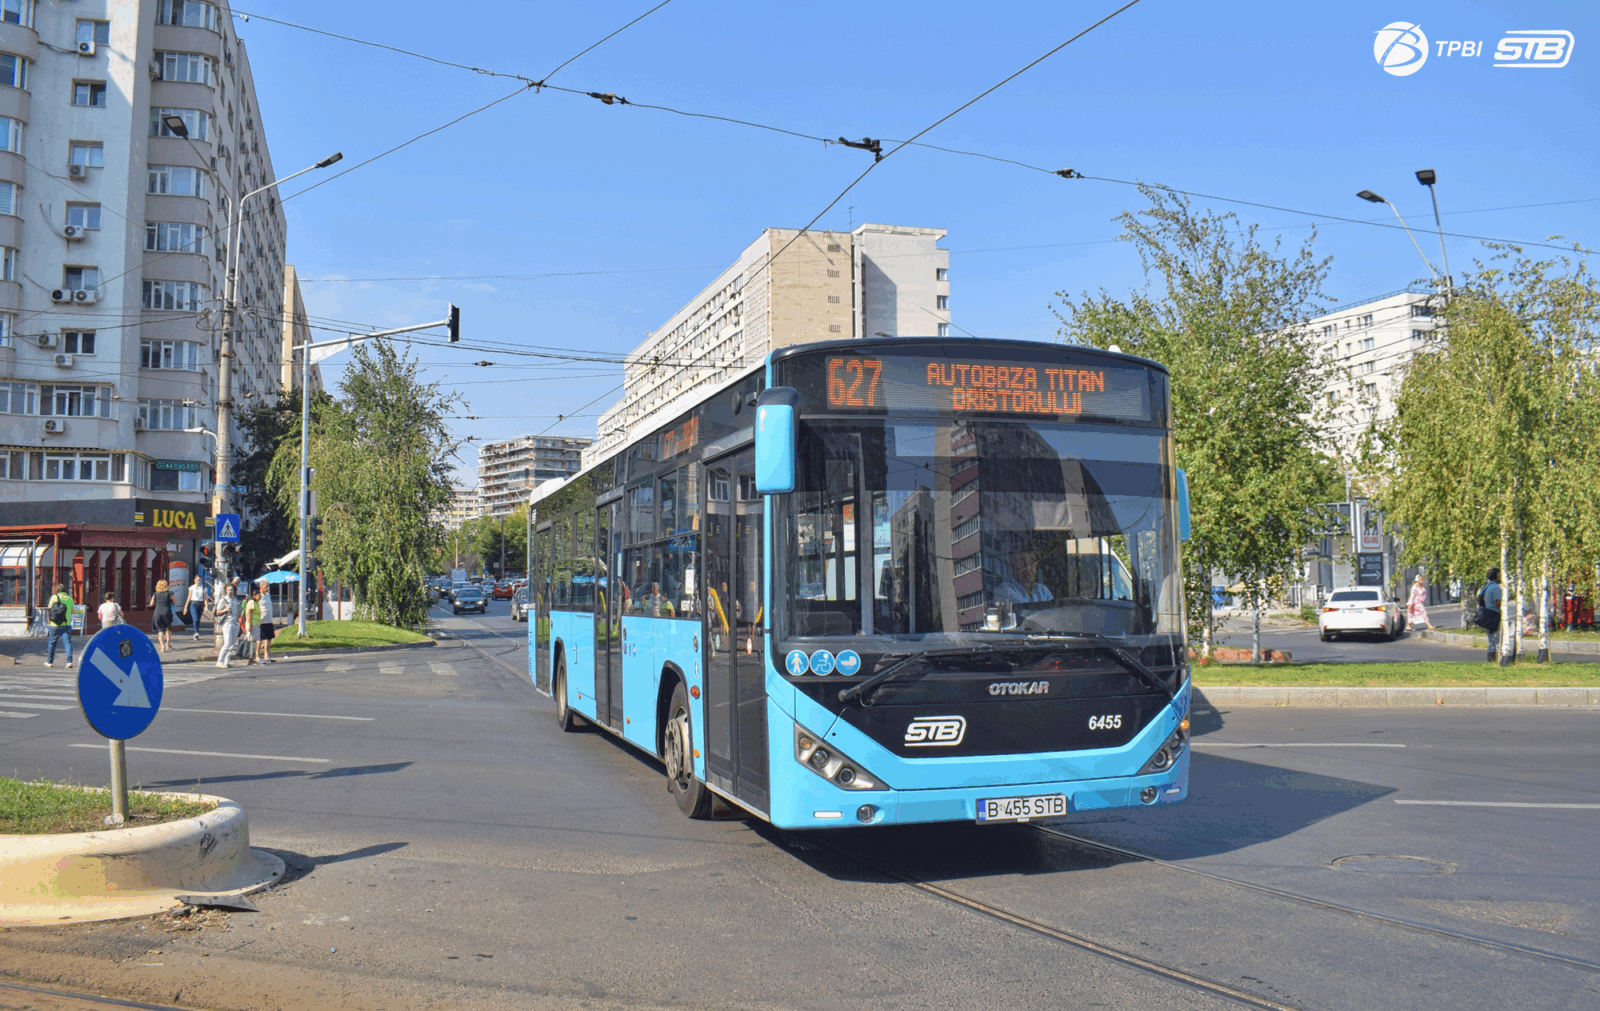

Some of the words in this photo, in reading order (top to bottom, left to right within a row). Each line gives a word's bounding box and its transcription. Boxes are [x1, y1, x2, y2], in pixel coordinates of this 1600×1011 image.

[828, 358, 882, 407] 627
[927, 363, 1037, 389] AUTOBAZA
[1045, 368, 1104, 393] TITAN
[152, 509, 197, 530] LUCA
[988, 681, 1050, 695] OTOKAR
[904, 720, 961, 743] STB
[1088, 715, 1122, 730] 6455
[988, 801, 999, 818] B
[1005, 799, 1031, 816] 455
[1034, 797, 1064, 814] STB
